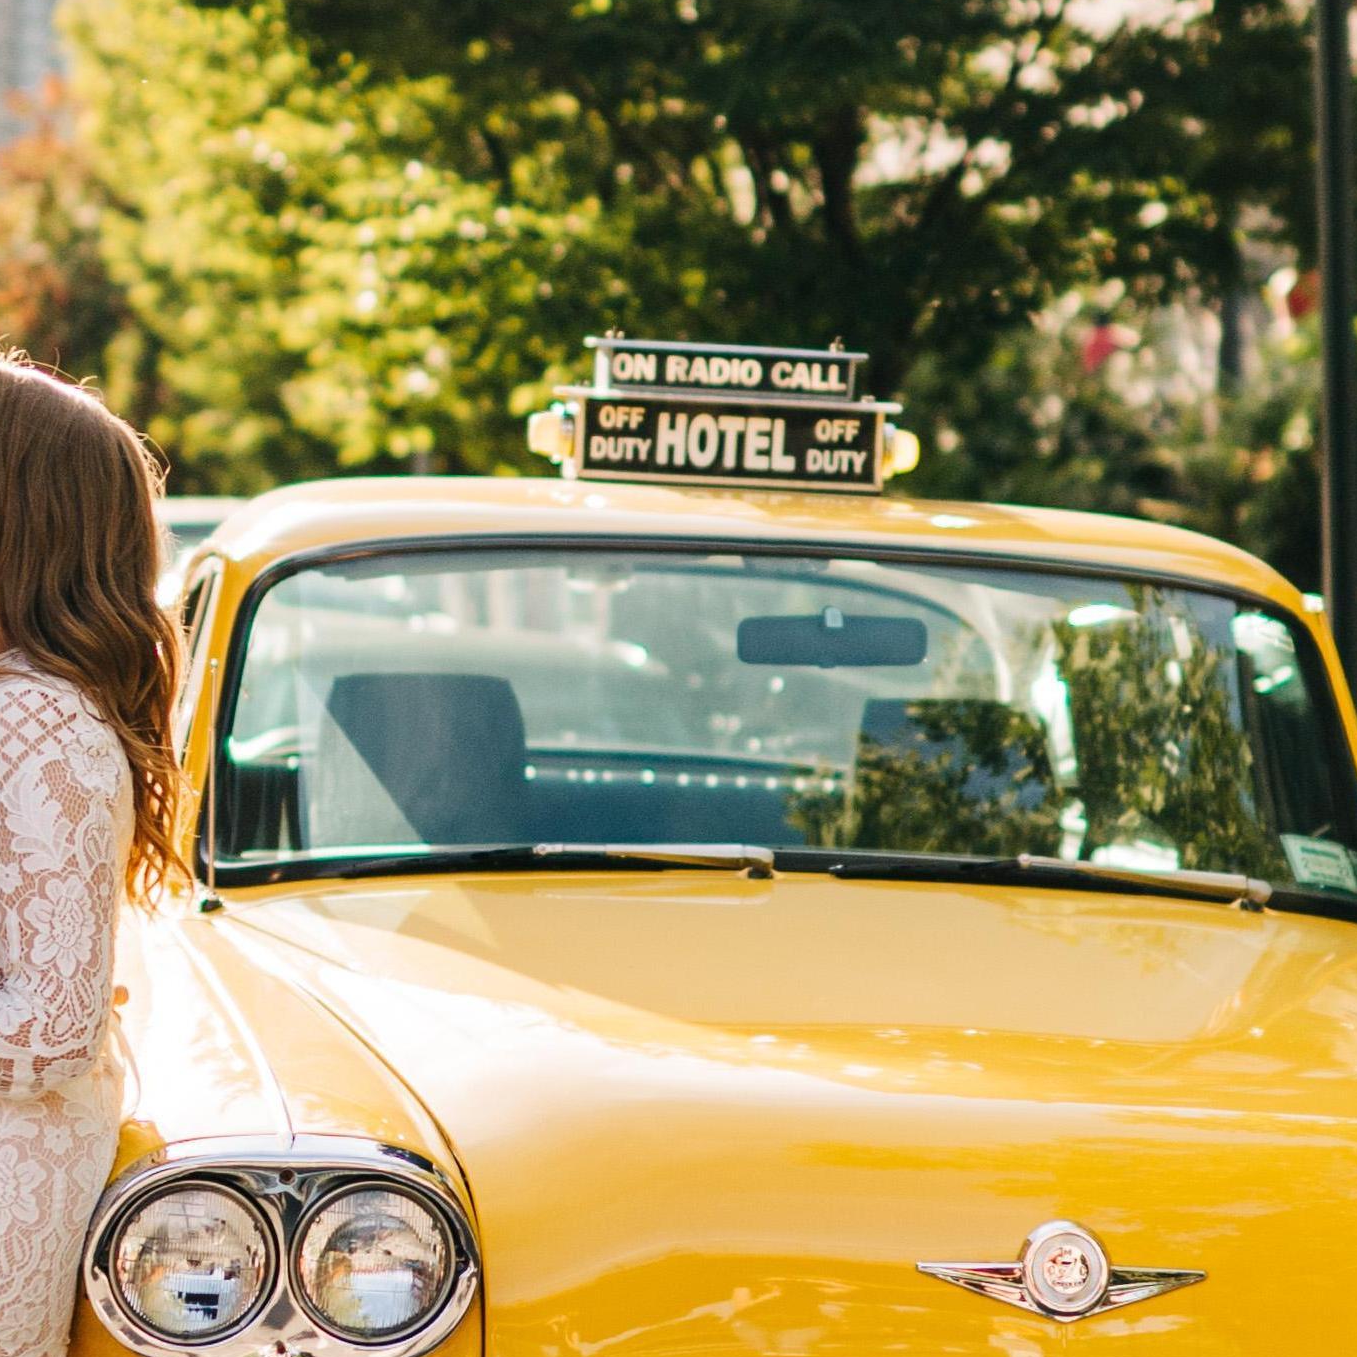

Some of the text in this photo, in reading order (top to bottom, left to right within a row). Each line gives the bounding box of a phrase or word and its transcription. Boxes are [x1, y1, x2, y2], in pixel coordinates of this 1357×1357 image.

[612, 352, 846, 392] ON RADIO CALL
[599, 405, 646, 430] OFF
[655, 412, 795, 472] HOTEL
[815, 419, 860, 443] OFF
[589, 436, 651, 462] DUTY
[805, 449, 866, 474] DUTY
